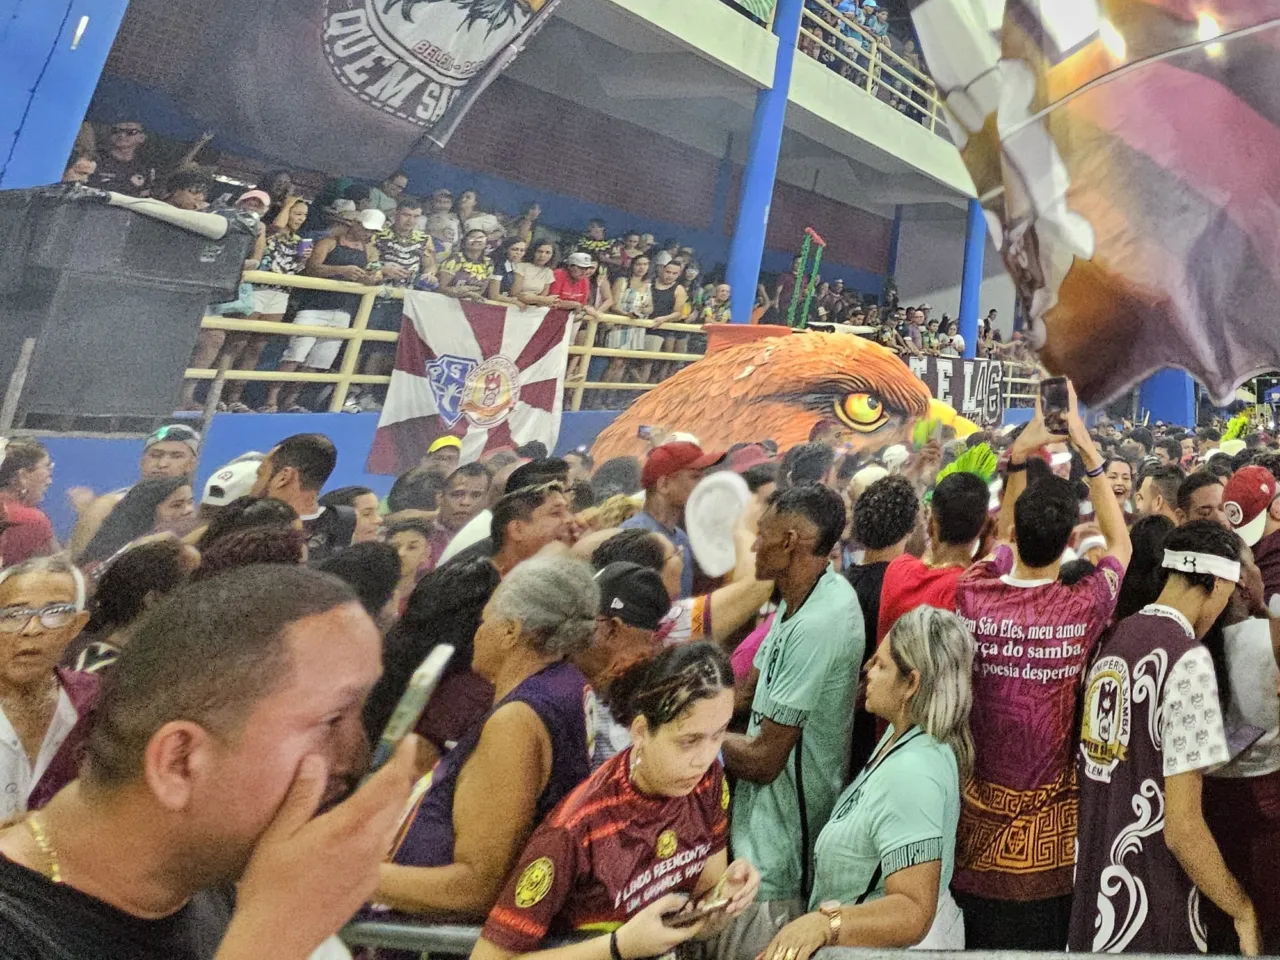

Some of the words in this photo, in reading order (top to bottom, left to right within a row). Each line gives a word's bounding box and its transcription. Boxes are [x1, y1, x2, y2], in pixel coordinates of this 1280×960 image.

[324, 8, 427, 108] QUEM
[977, 616, 998, 636] São
[1000, 619, 1026, 641] Eles,
[1027, 625, 1054, 640] meu
[1056, 623, 1087, 639] amor
[1002, 641, 1023, 657] do
[1027, 641, 1084, 659] samba,
[982, 663, 1019, 677] poesia
[623, 869, 652, 902] LINDO
